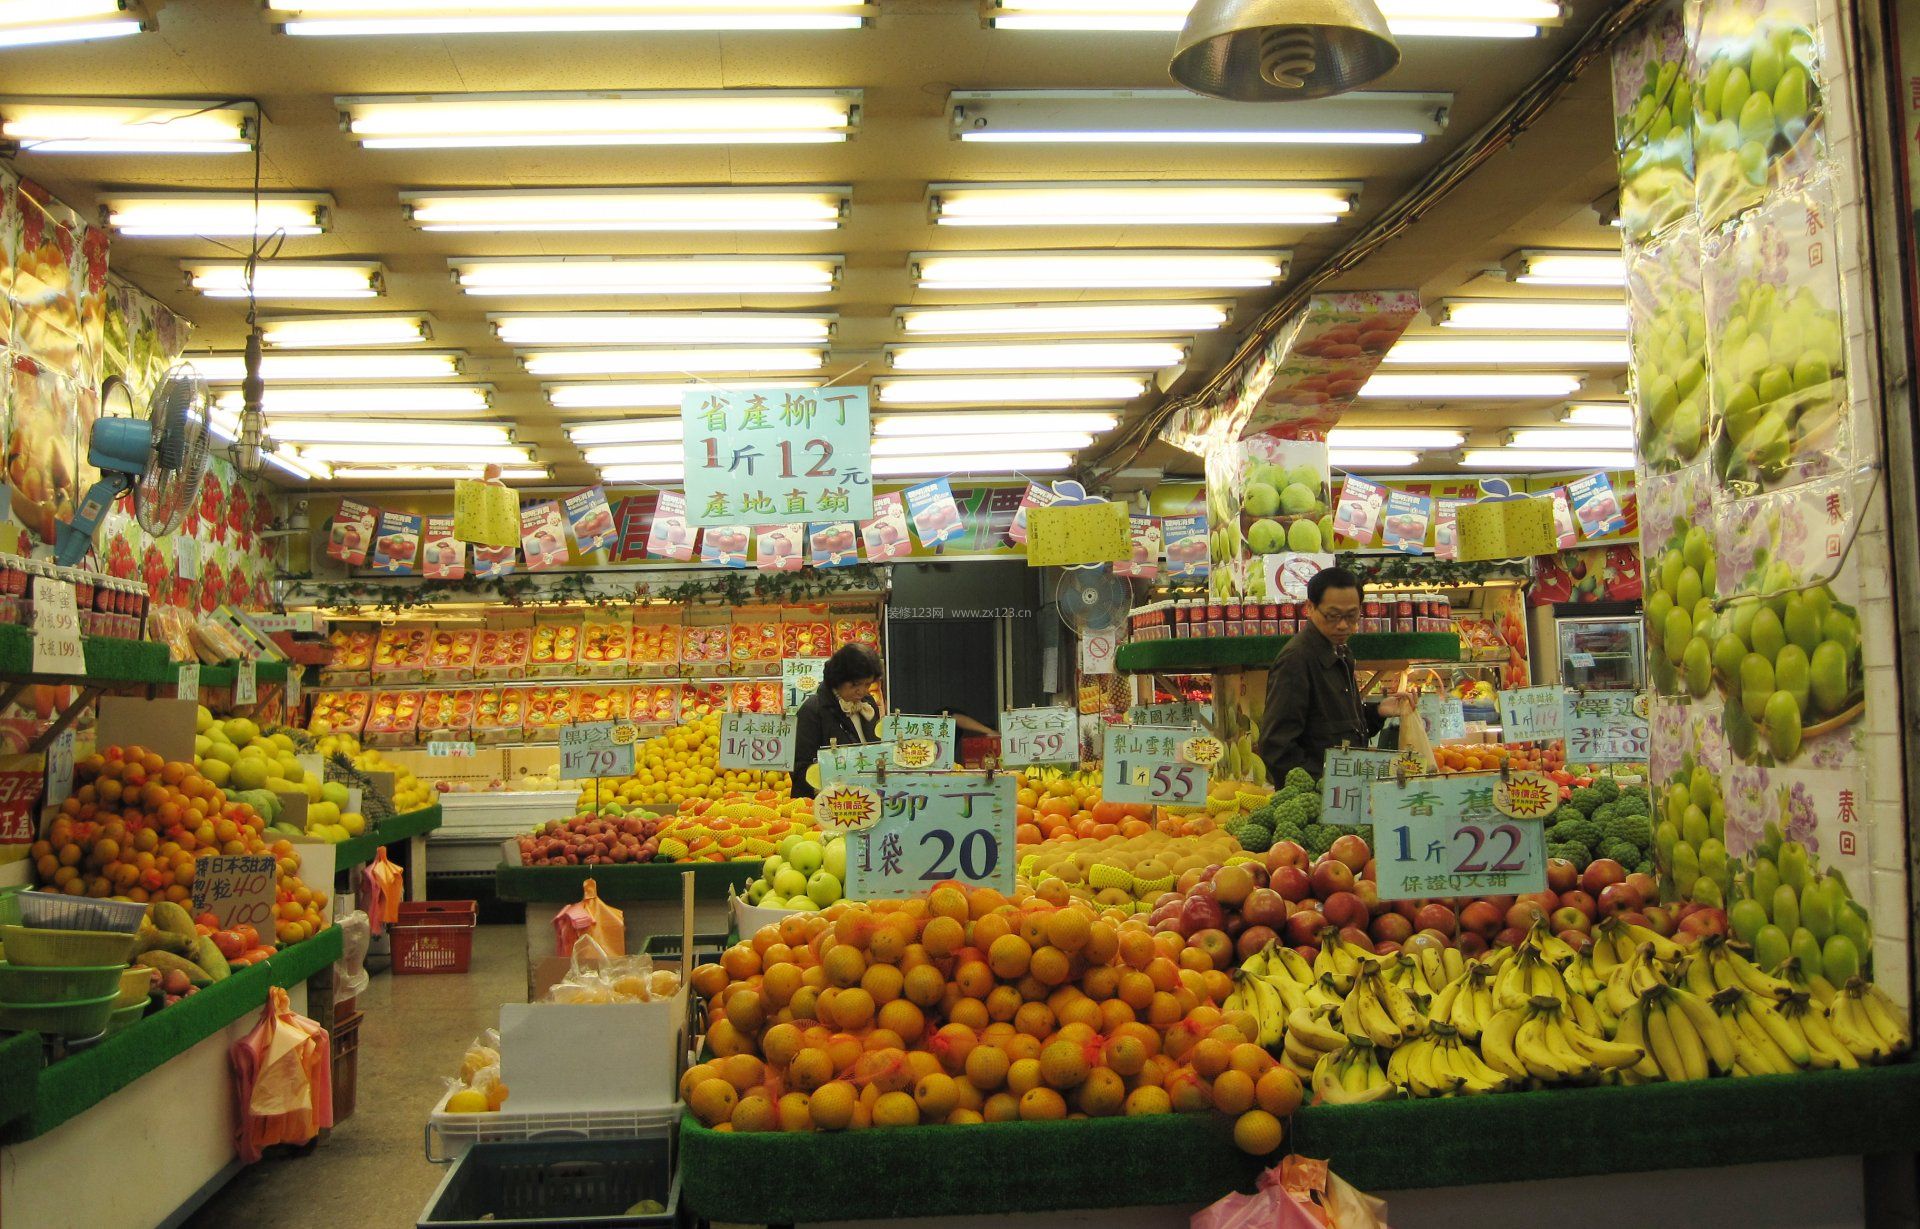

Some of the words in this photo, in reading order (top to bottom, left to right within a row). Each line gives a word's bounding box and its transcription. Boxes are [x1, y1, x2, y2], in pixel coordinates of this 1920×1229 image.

[698, 393, 859, 432] 省產柳丁
[701, 487, 851, 519] 產地直銷
[1825, 494, 1845, 559] 春回
[729, 719, 791, 737] 日本甜柿
[889, 719, 950, 738] 牛奶蜜棗
[1008, 713, 1068, 731] 茂谷
[1114, 734, 1176, 757] 梨山雪梨
[1116, 760, 1195, 798] 1斤55
[1510, 789, 1539, 799] 特價品
[833, 800, 863, 810] 特價品
[877, 788, 996, 821] 柳丁
[1398, 788, 1493, 817] 香蕉
[1837, 788, 1857, 856] 春回
[858, 829, 999, 881] 1袋20
[1392, 825, 1525, 872] 1斤22
[1401, 874, 1508, 893] 保證Q又甜
